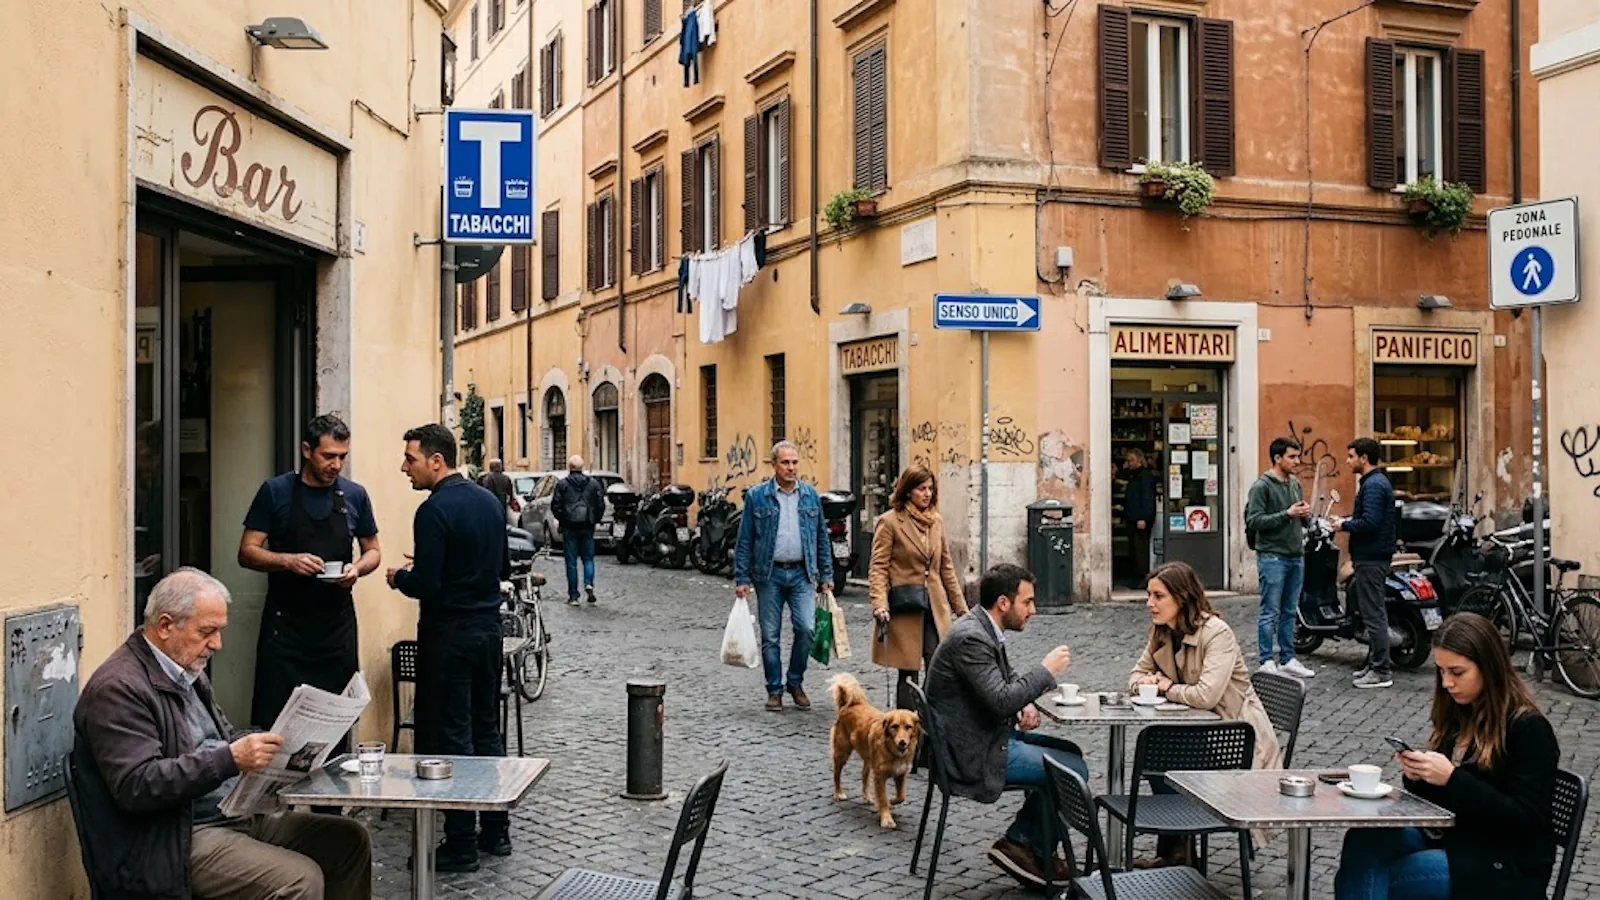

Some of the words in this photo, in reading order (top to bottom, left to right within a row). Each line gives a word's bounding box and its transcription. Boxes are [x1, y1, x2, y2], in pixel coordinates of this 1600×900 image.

[181, 105, 302, 221] Bar
[459, 120, 522, 209] T
[450, 213, 530, 234] TABACCHI
[1516, 209, 1546, 224] ZONA
[1503, 223, 1562, 242] PEDONALE
[940, 304, 979, 319] SENSO
[843, 340, 896, 369] TABACCHI
[1114, 330, 1230, 356] ALIMENTARI
[1376, 336, 1472, 359] PANIFICIO
